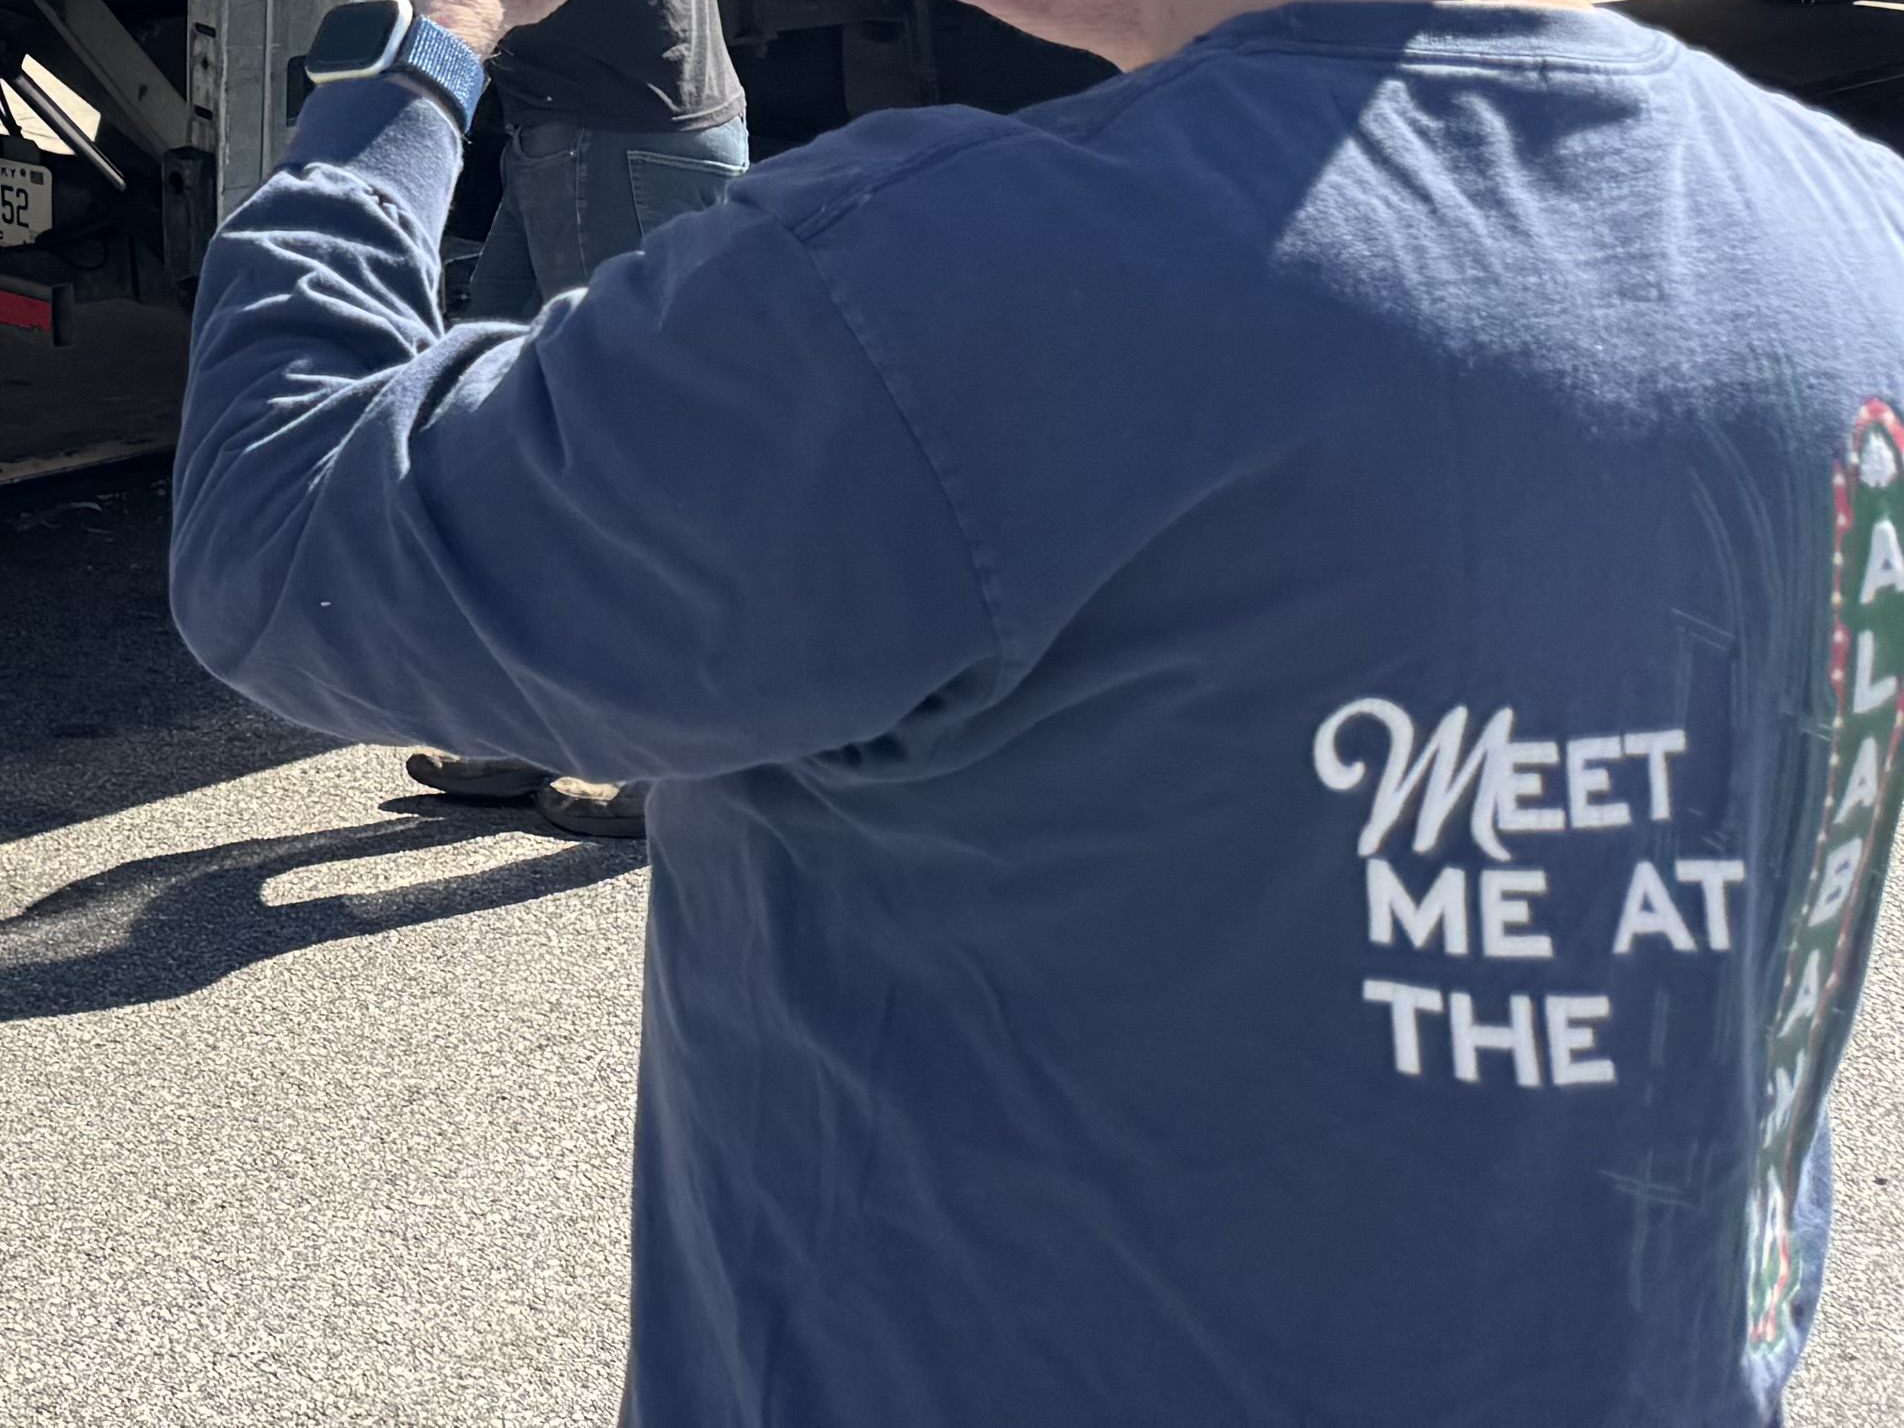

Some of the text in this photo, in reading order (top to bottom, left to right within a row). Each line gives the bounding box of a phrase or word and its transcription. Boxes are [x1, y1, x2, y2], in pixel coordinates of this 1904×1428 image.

[1368, 859, 1745, 956] ME AT
[1364, 981, 1614, 1085] THE
